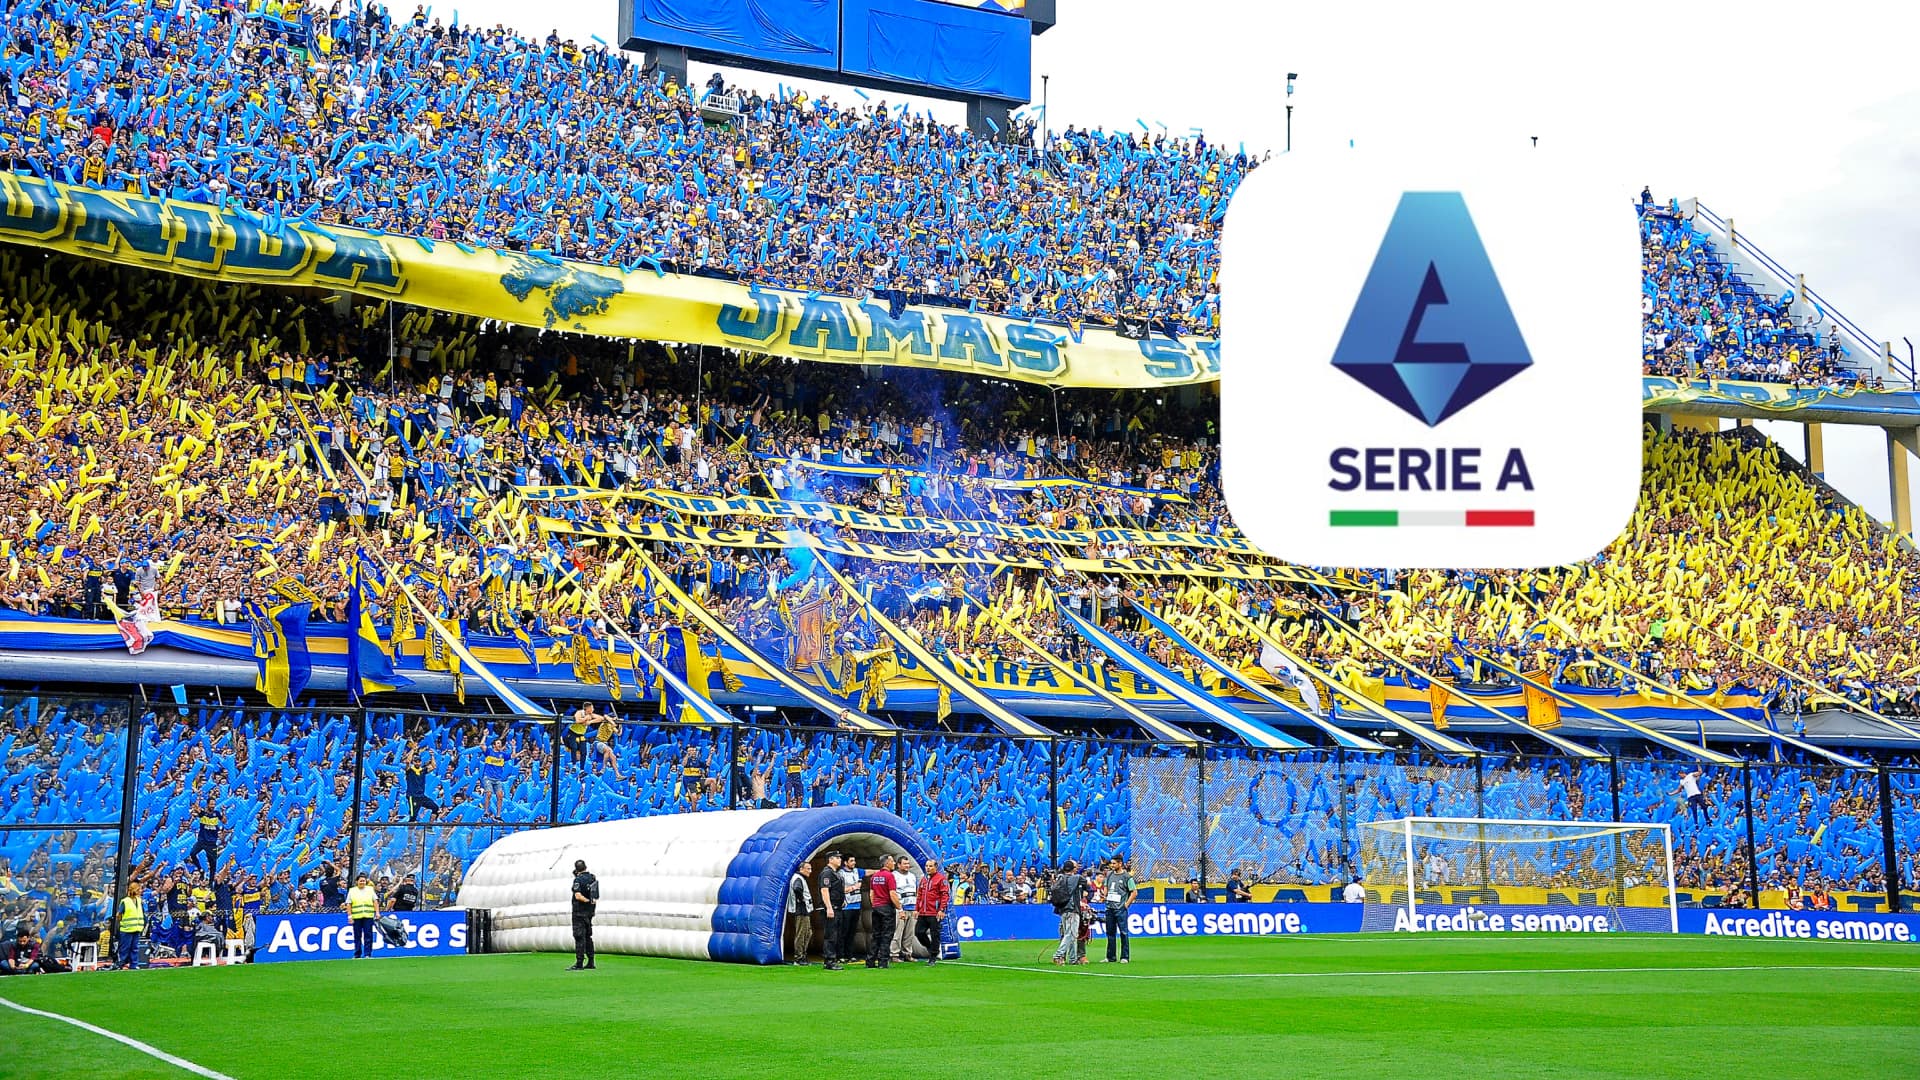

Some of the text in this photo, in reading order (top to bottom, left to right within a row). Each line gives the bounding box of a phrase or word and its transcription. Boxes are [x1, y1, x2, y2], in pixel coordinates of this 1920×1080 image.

[717, 292, 1062, 373] JAMAS
[572, 521, 788, 545] NUNCA
[1102, 558, 1318, 581] AMISTAD
[1194, 534, 1250, 550] HIS
[1203, 911, 1307, 936] sempre.
[1704, 911, 1811, 938] Acredite
